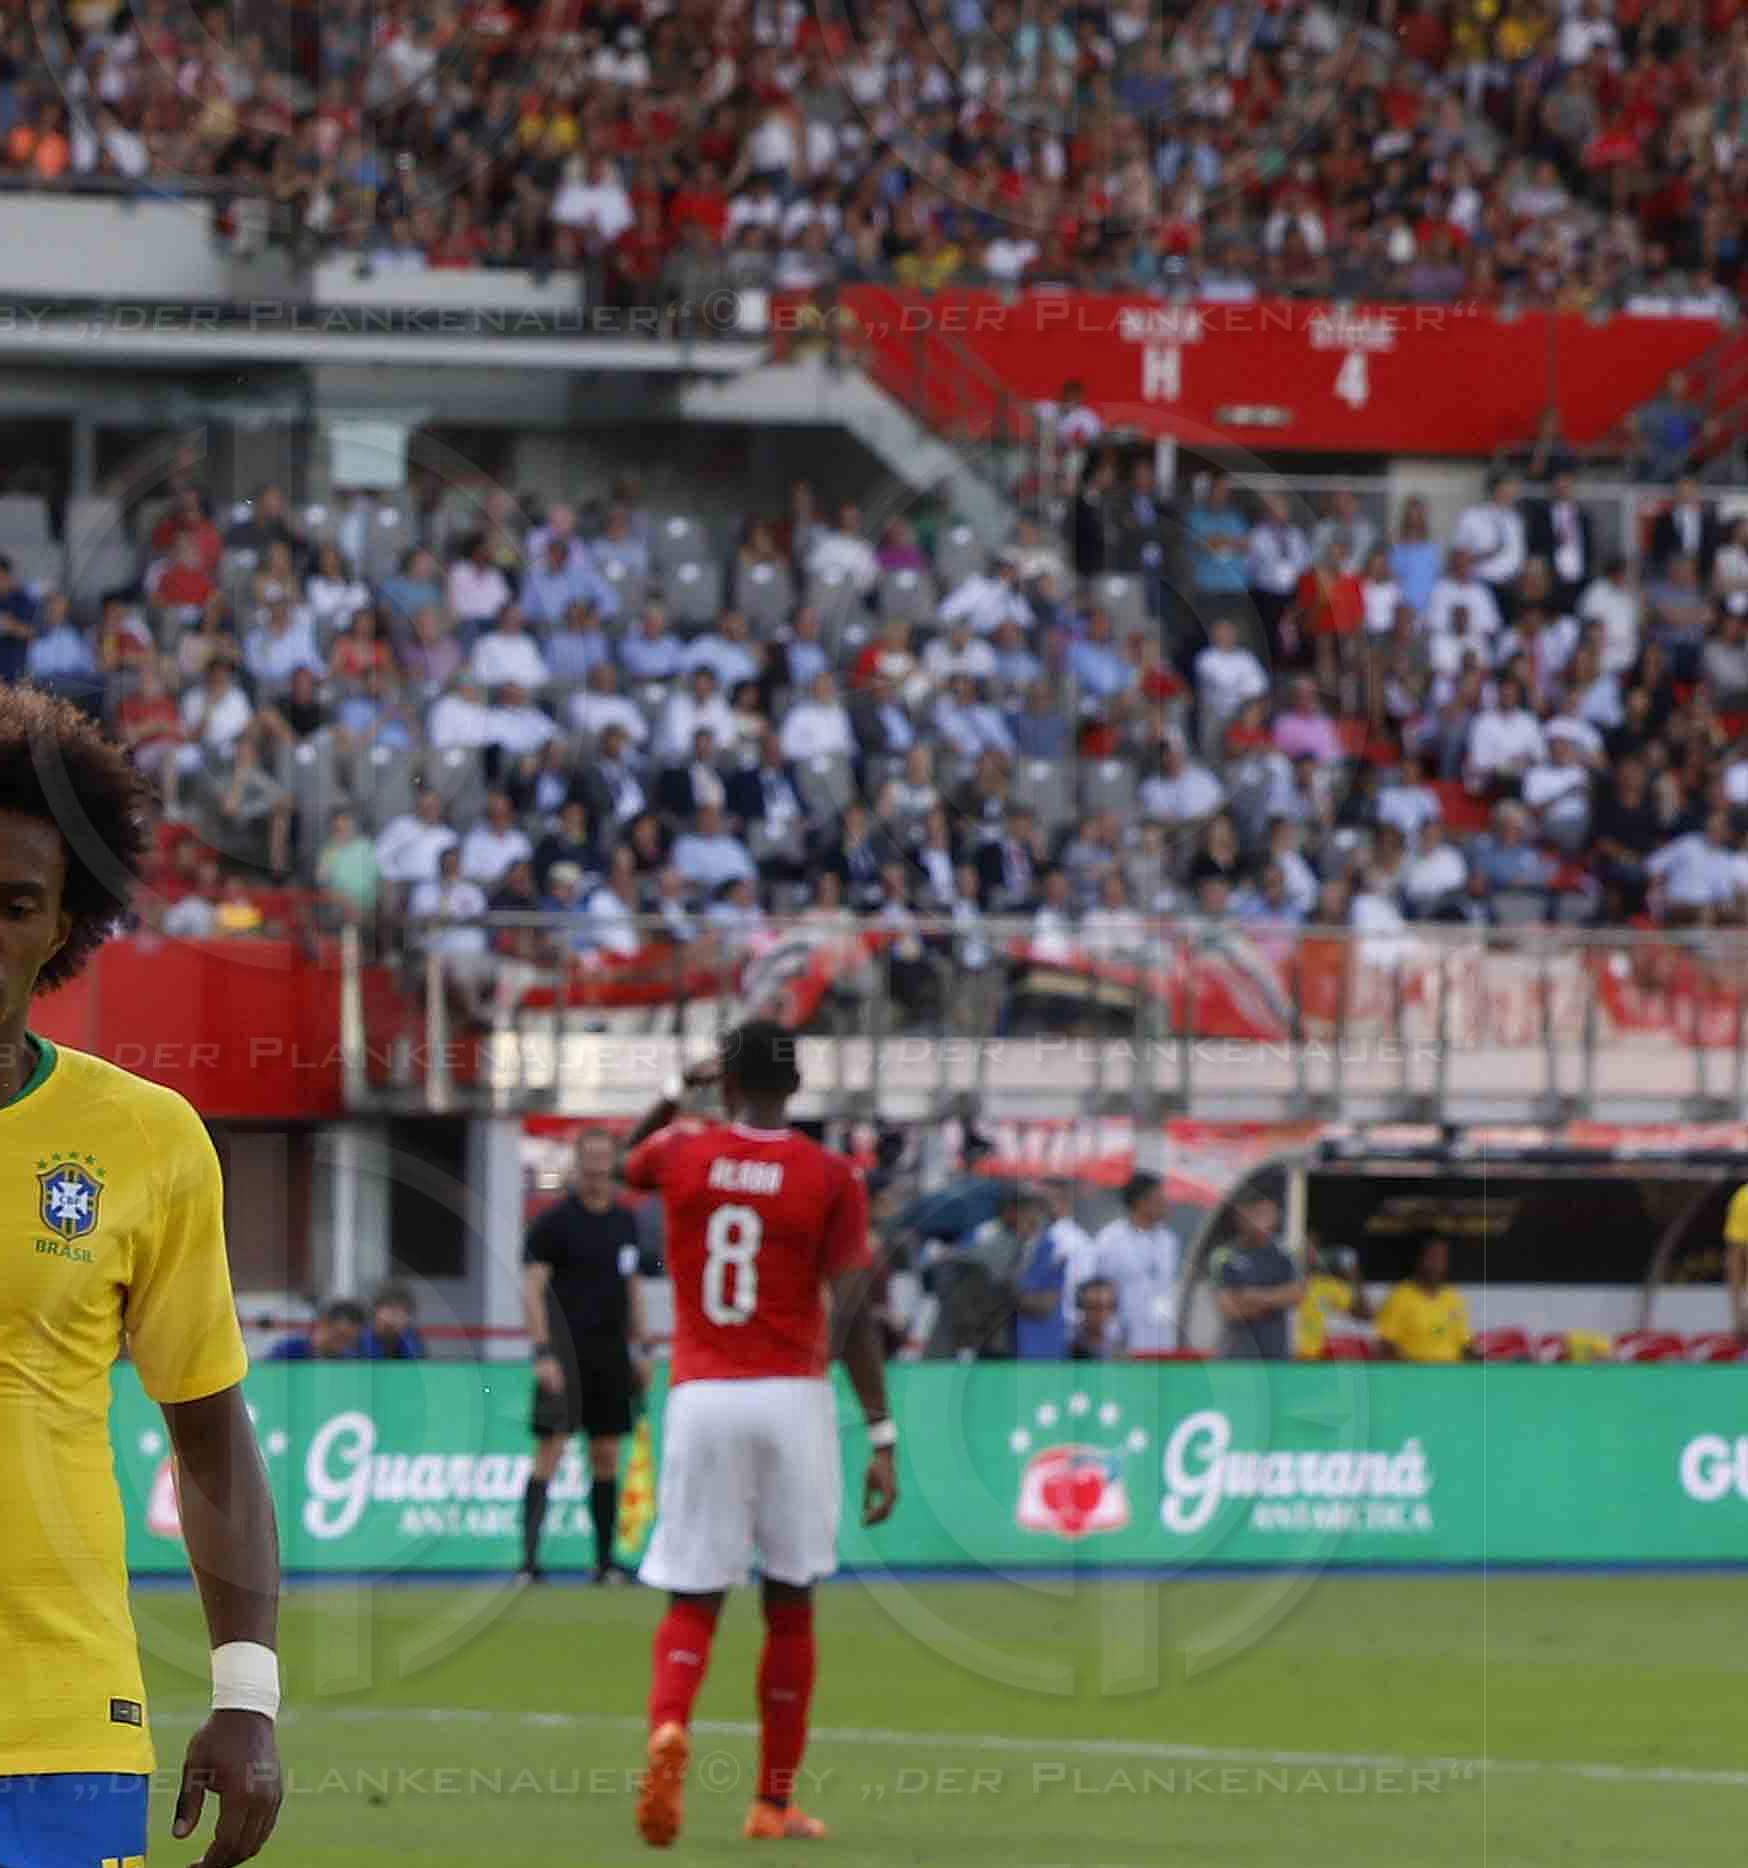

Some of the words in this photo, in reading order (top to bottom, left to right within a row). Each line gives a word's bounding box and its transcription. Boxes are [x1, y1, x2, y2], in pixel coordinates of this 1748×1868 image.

[35, 1238, 96, 1265] BRASIL
[702, 1203, 764, 1328] 8
[1161, 1410, 1432, 1534] Guaraná
